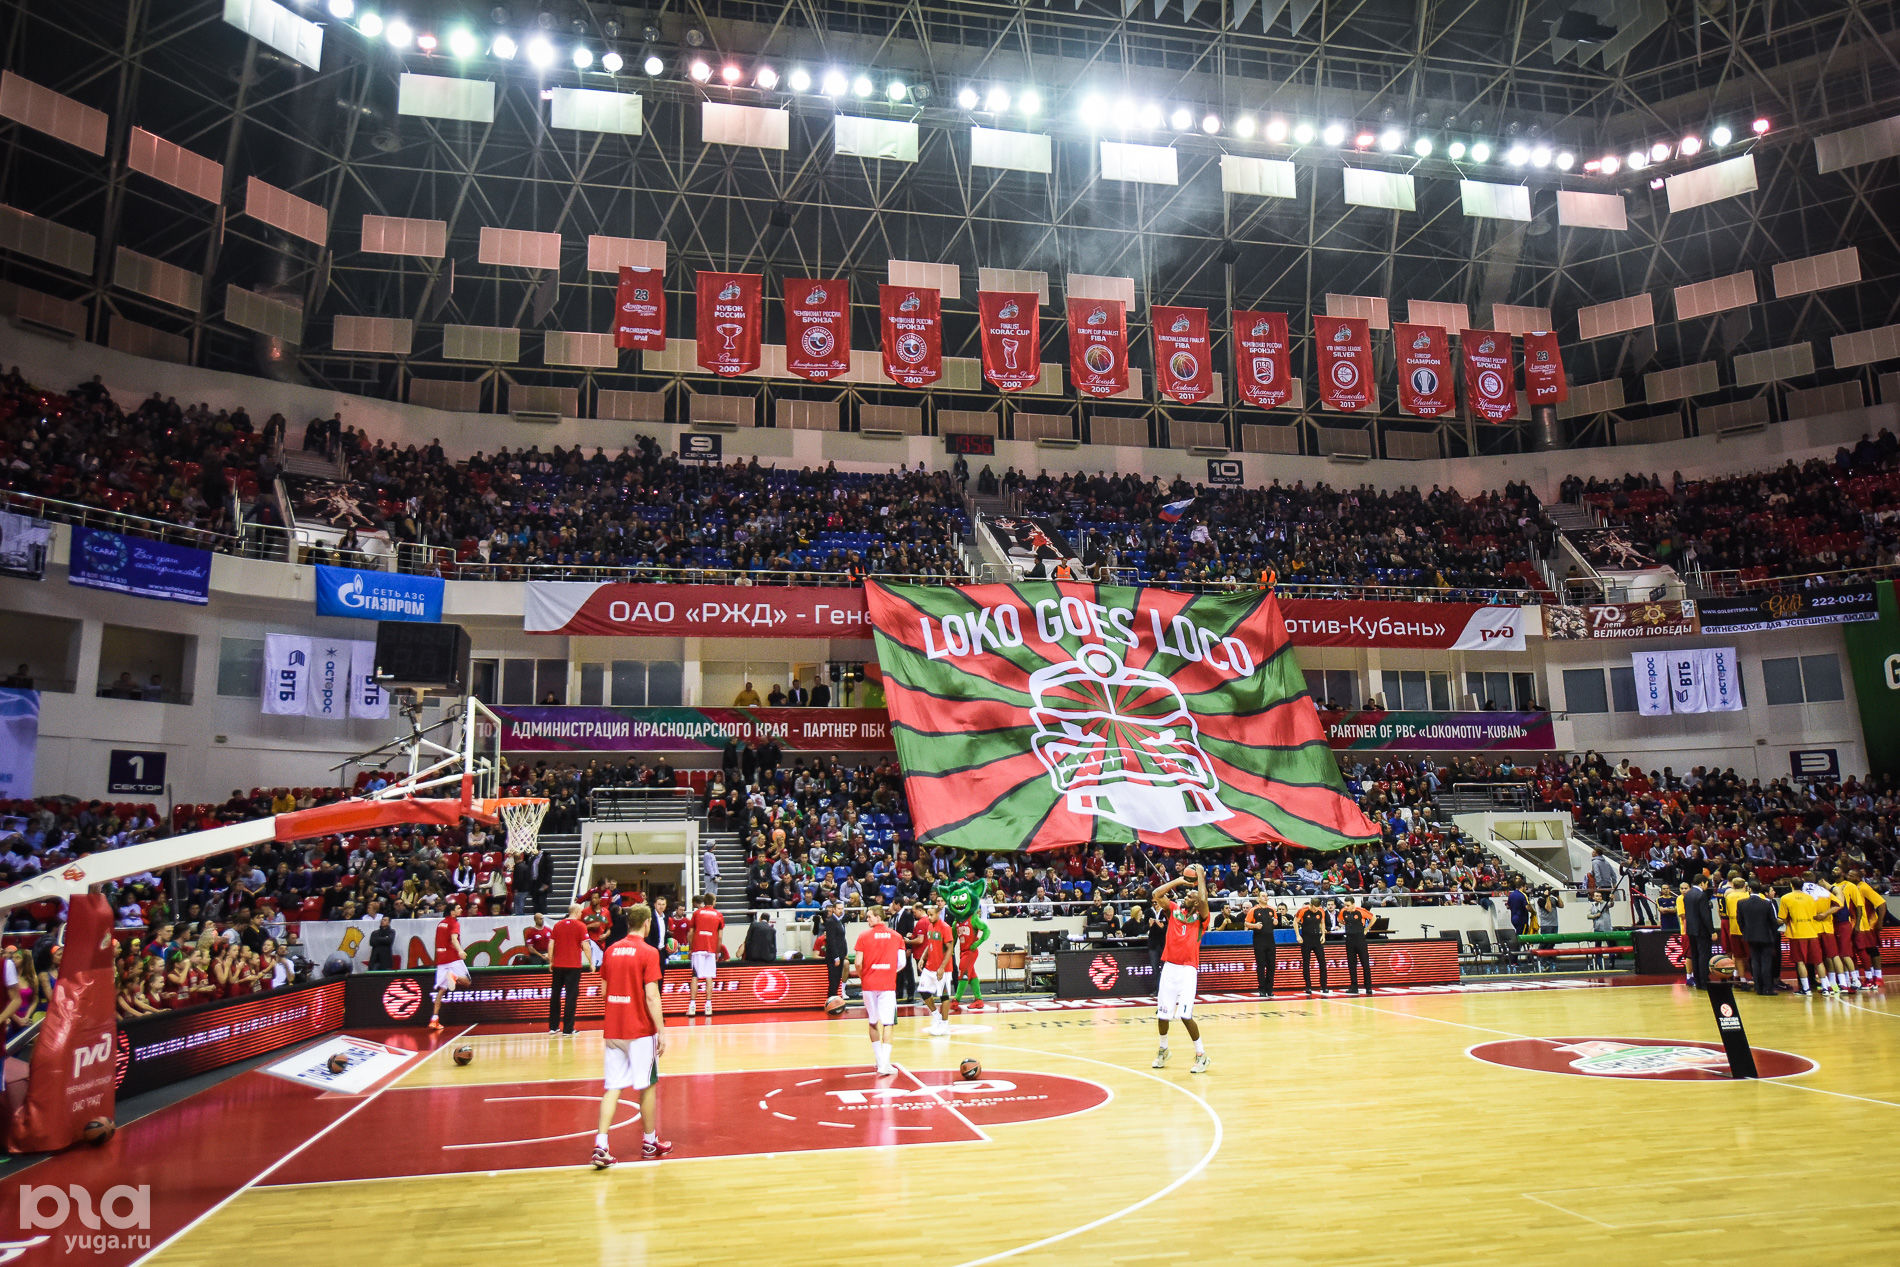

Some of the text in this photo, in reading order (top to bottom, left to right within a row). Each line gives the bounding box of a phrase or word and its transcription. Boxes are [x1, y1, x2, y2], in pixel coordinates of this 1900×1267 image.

[634, 288, 648, 300] 23
[1536, 351, 1548, 361] 23
[690, 436, 712, 451] 9
[1211, 462, 1239, 476] 10
[374, 588, 425, 600] СЕТЬ АЗС
[1812, 592, 1873, 607] 222-00-22
[365, 597, 425, 616] ГАЗПРОМ
[609, 601, 675, 622] ОАО
[686, 602, 788, 627] «РЖД»
[1589, 606, 1622, 628] 70
[1705, 612, 1876, 633] ФИТНЕС-КЛУБ ДЛЯ УСПЕШНЫХ ЛЮДЕЙ
[919, 597, 1256, 676] LOKO GOES LOCO
[1594, 625, 1692, 638] ВЕЛИКОЙ ПОБЕДЫ
[1646, 657, 1658, 699] астерос
[1678, 661, 1692, 686] ВТБ
[1715, 653, 1727, 695] астерос
[280, 670, 296, 702] ВТБ
[323, 660, 335, 714] астерос
[512, 721, 630, 739] АДМИНИСТРАЦИЯ
[634, 722, 752, 739] КРАСНОДАРСКОГО
[756, 723, 789, 738] КРАЯ
[803, 724, 857, 738] ПАРТНЕР
[861, 724, 885, 738] ПБК
[1330, 724, 1377, 739] PARTNER
[1380, 724, 1393, 738] OF
[1396, 724, 1416, 738] PBC
[1418, 724, 1528, 739] «LOKOMOTIV-KUBAN»
[128, 756, 145, 780] 1
[1800, 753, 1830, 771] 3
[112, 783, 162, 792] СЕКТОР
[135, 1006, 308, 1062] TURKISH AIRLINES EUROLEAGUE
